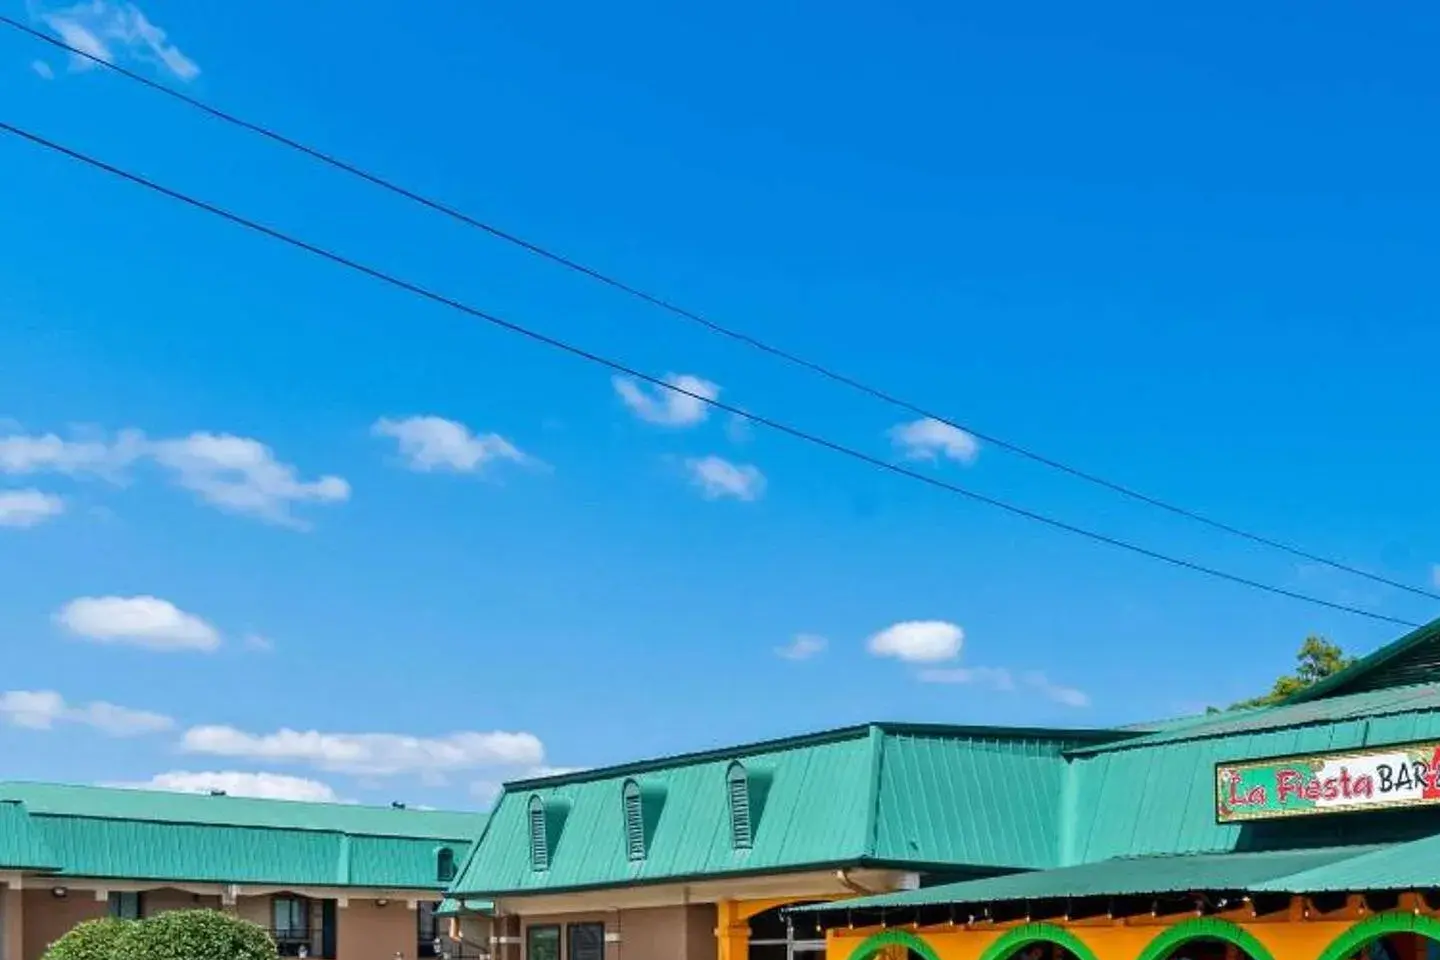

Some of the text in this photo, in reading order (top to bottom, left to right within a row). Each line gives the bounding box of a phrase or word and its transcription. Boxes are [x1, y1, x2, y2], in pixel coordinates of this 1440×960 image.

[1229, 769, 1266, 805] La
[1276, 766, 1374, 802] Fiesta
[1376, 760, 1428, 793] BAR
